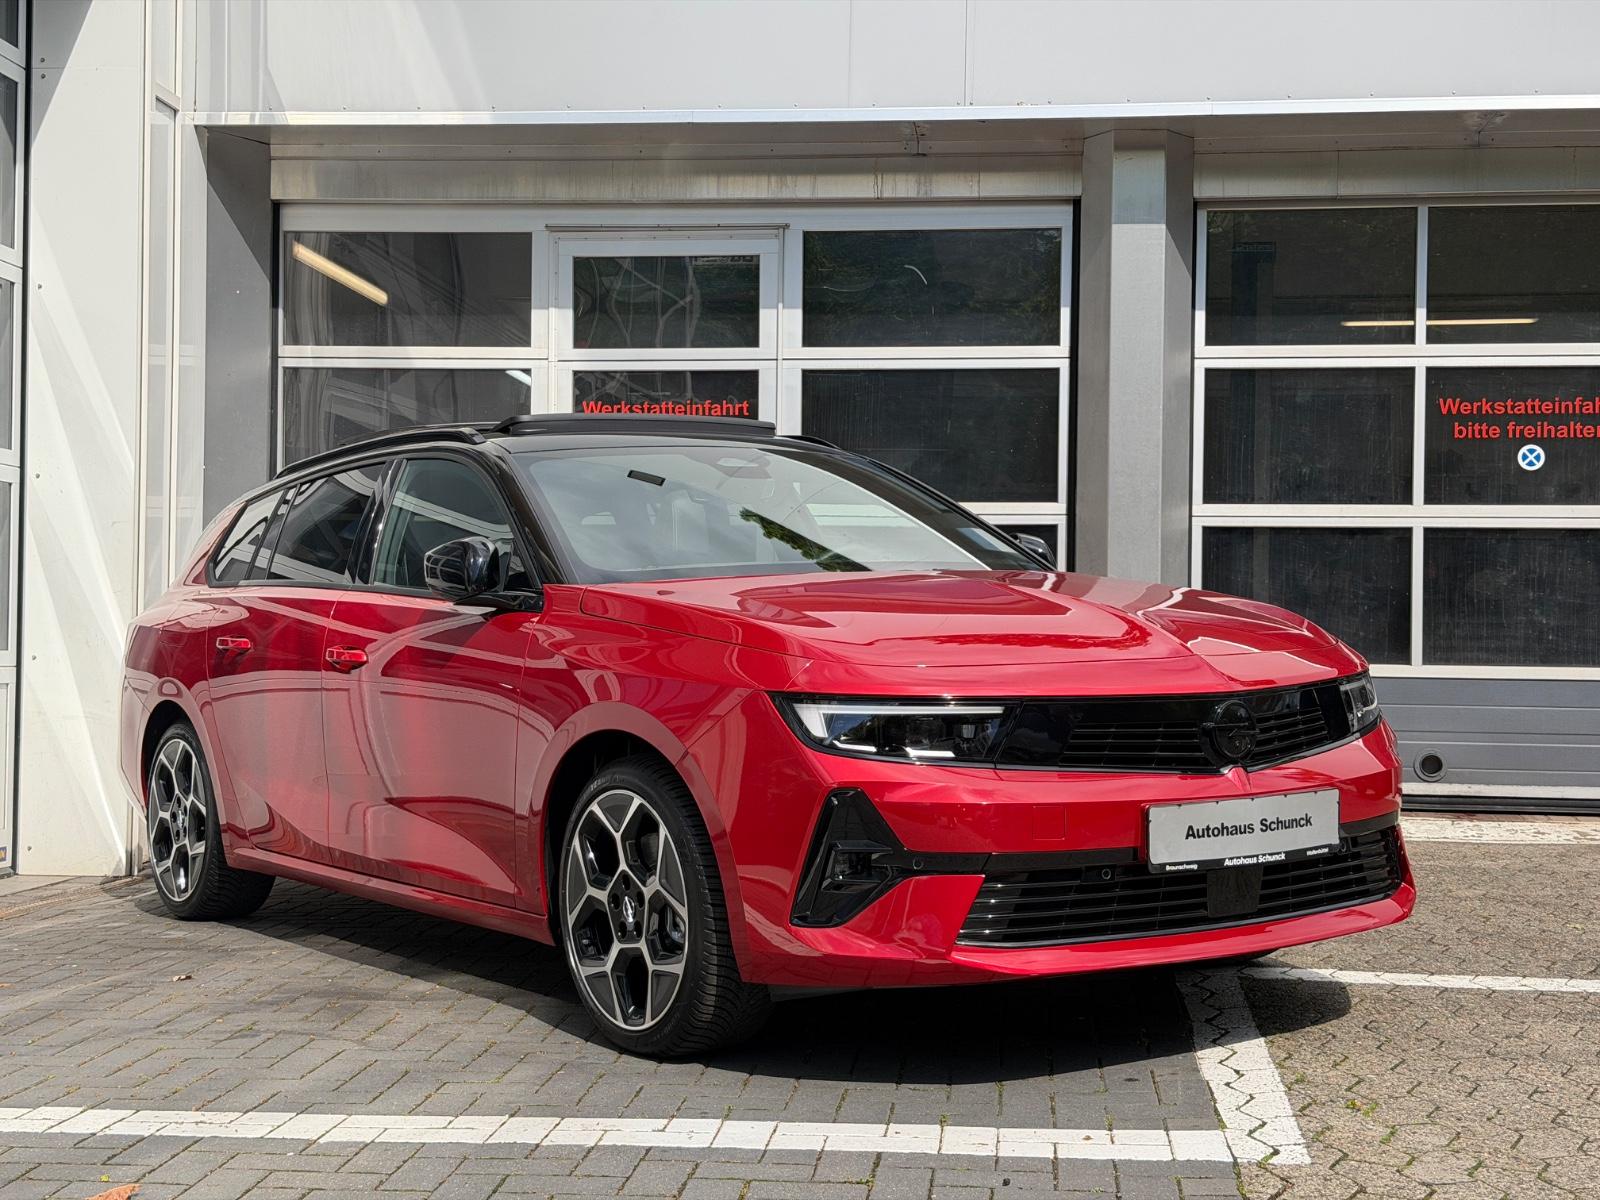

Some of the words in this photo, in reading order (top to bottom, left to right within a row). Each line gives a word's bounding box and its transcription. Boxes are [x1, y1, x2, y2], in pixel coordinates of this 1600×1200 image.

[582, 400, 750, 416] Werkstatteinfahrt
[1454, 422, 1501, 439] bitte
[1507, 421, 1600, 439] freihalte
[1184, 822, 1255, 840] Autohaus
[1259, 813, 1313, 833] Schunck
[1223, 855, 1257, 867] Autohaus
[1258, 851, 1286, 863] Schunck
